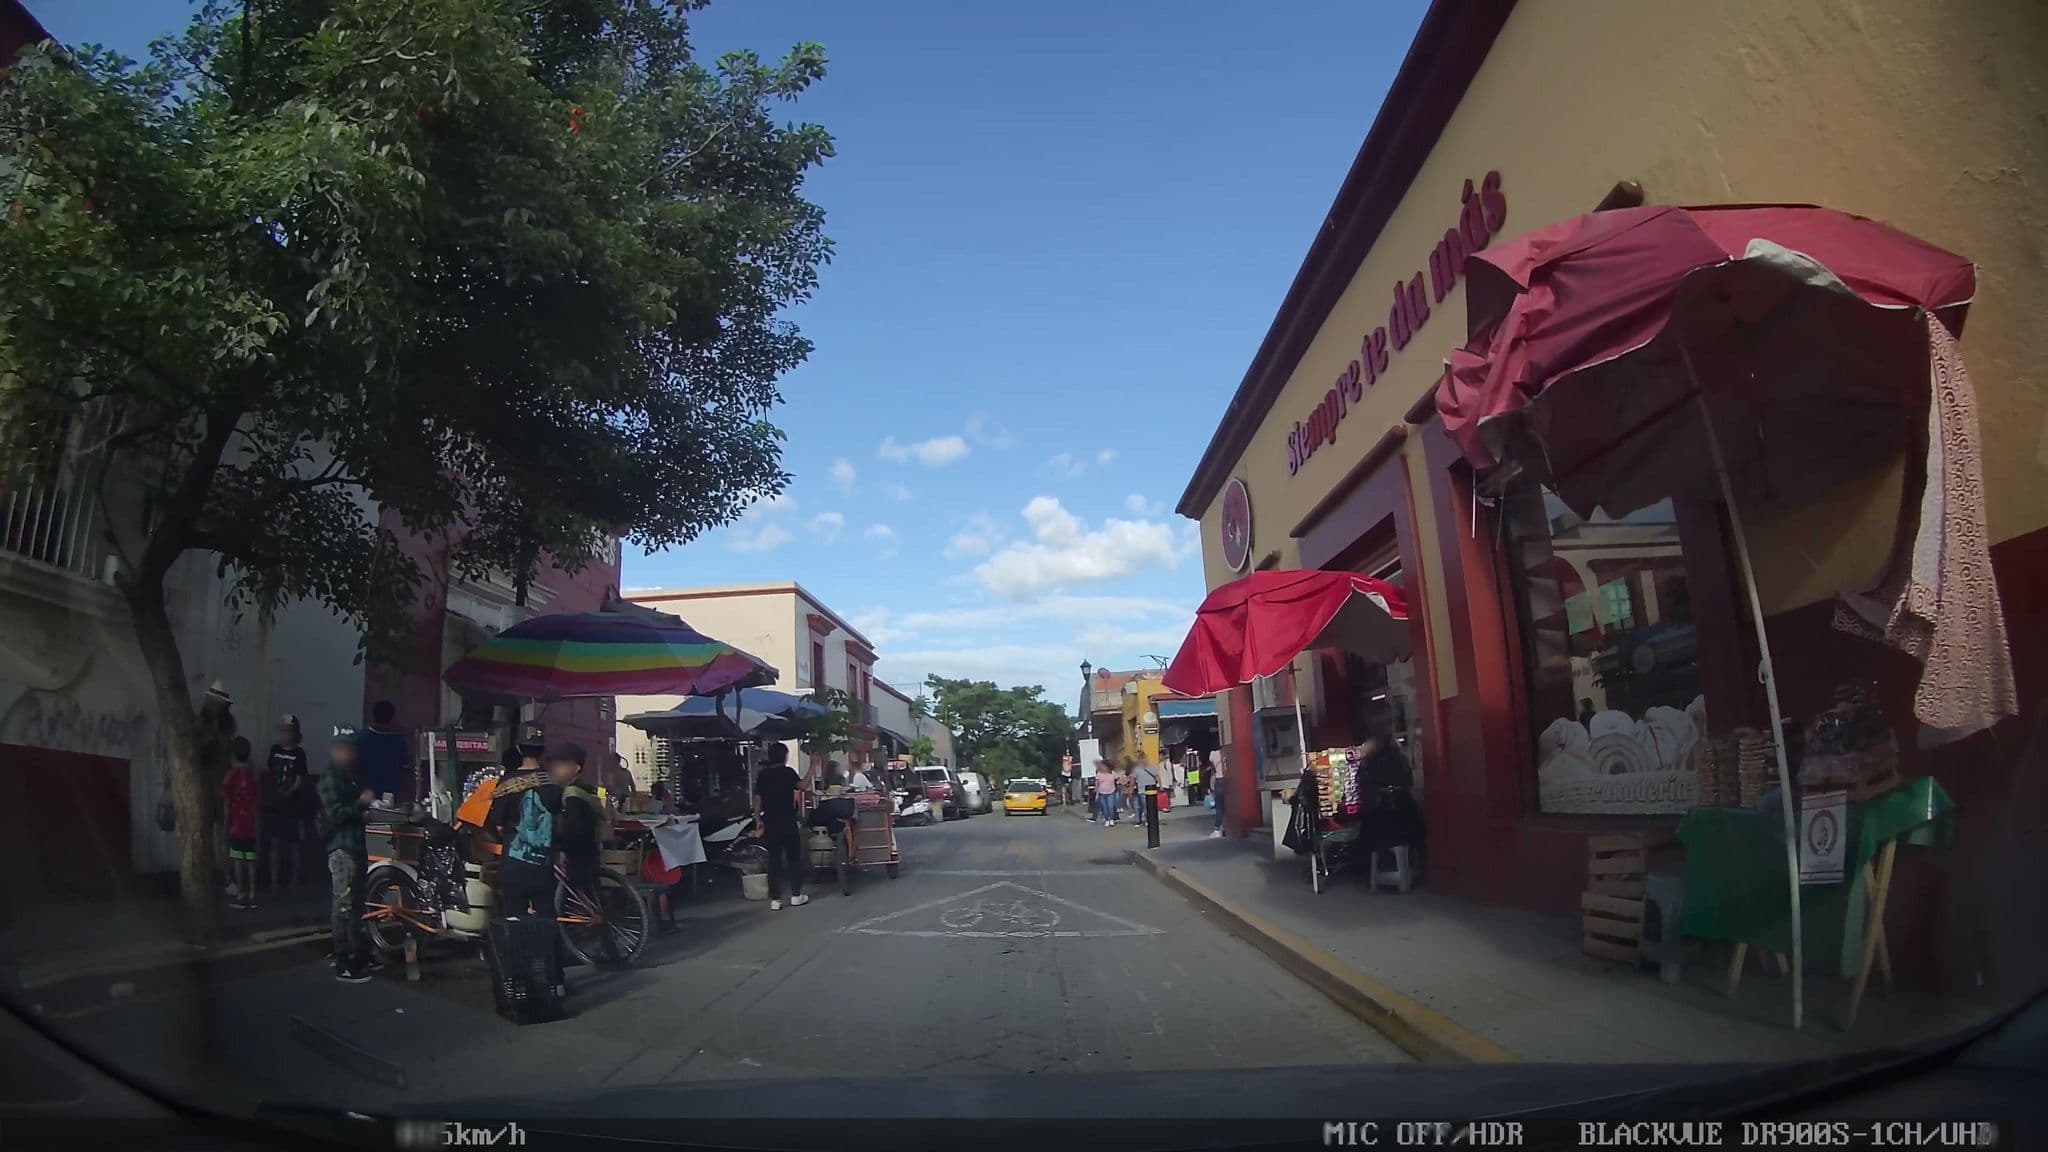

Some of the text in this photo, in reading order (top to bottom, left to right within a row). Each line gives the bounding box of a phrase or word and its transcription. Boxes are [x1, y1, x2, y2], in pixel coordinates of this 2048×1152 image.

[1287, 170, 1507, 476] siempre te da más
